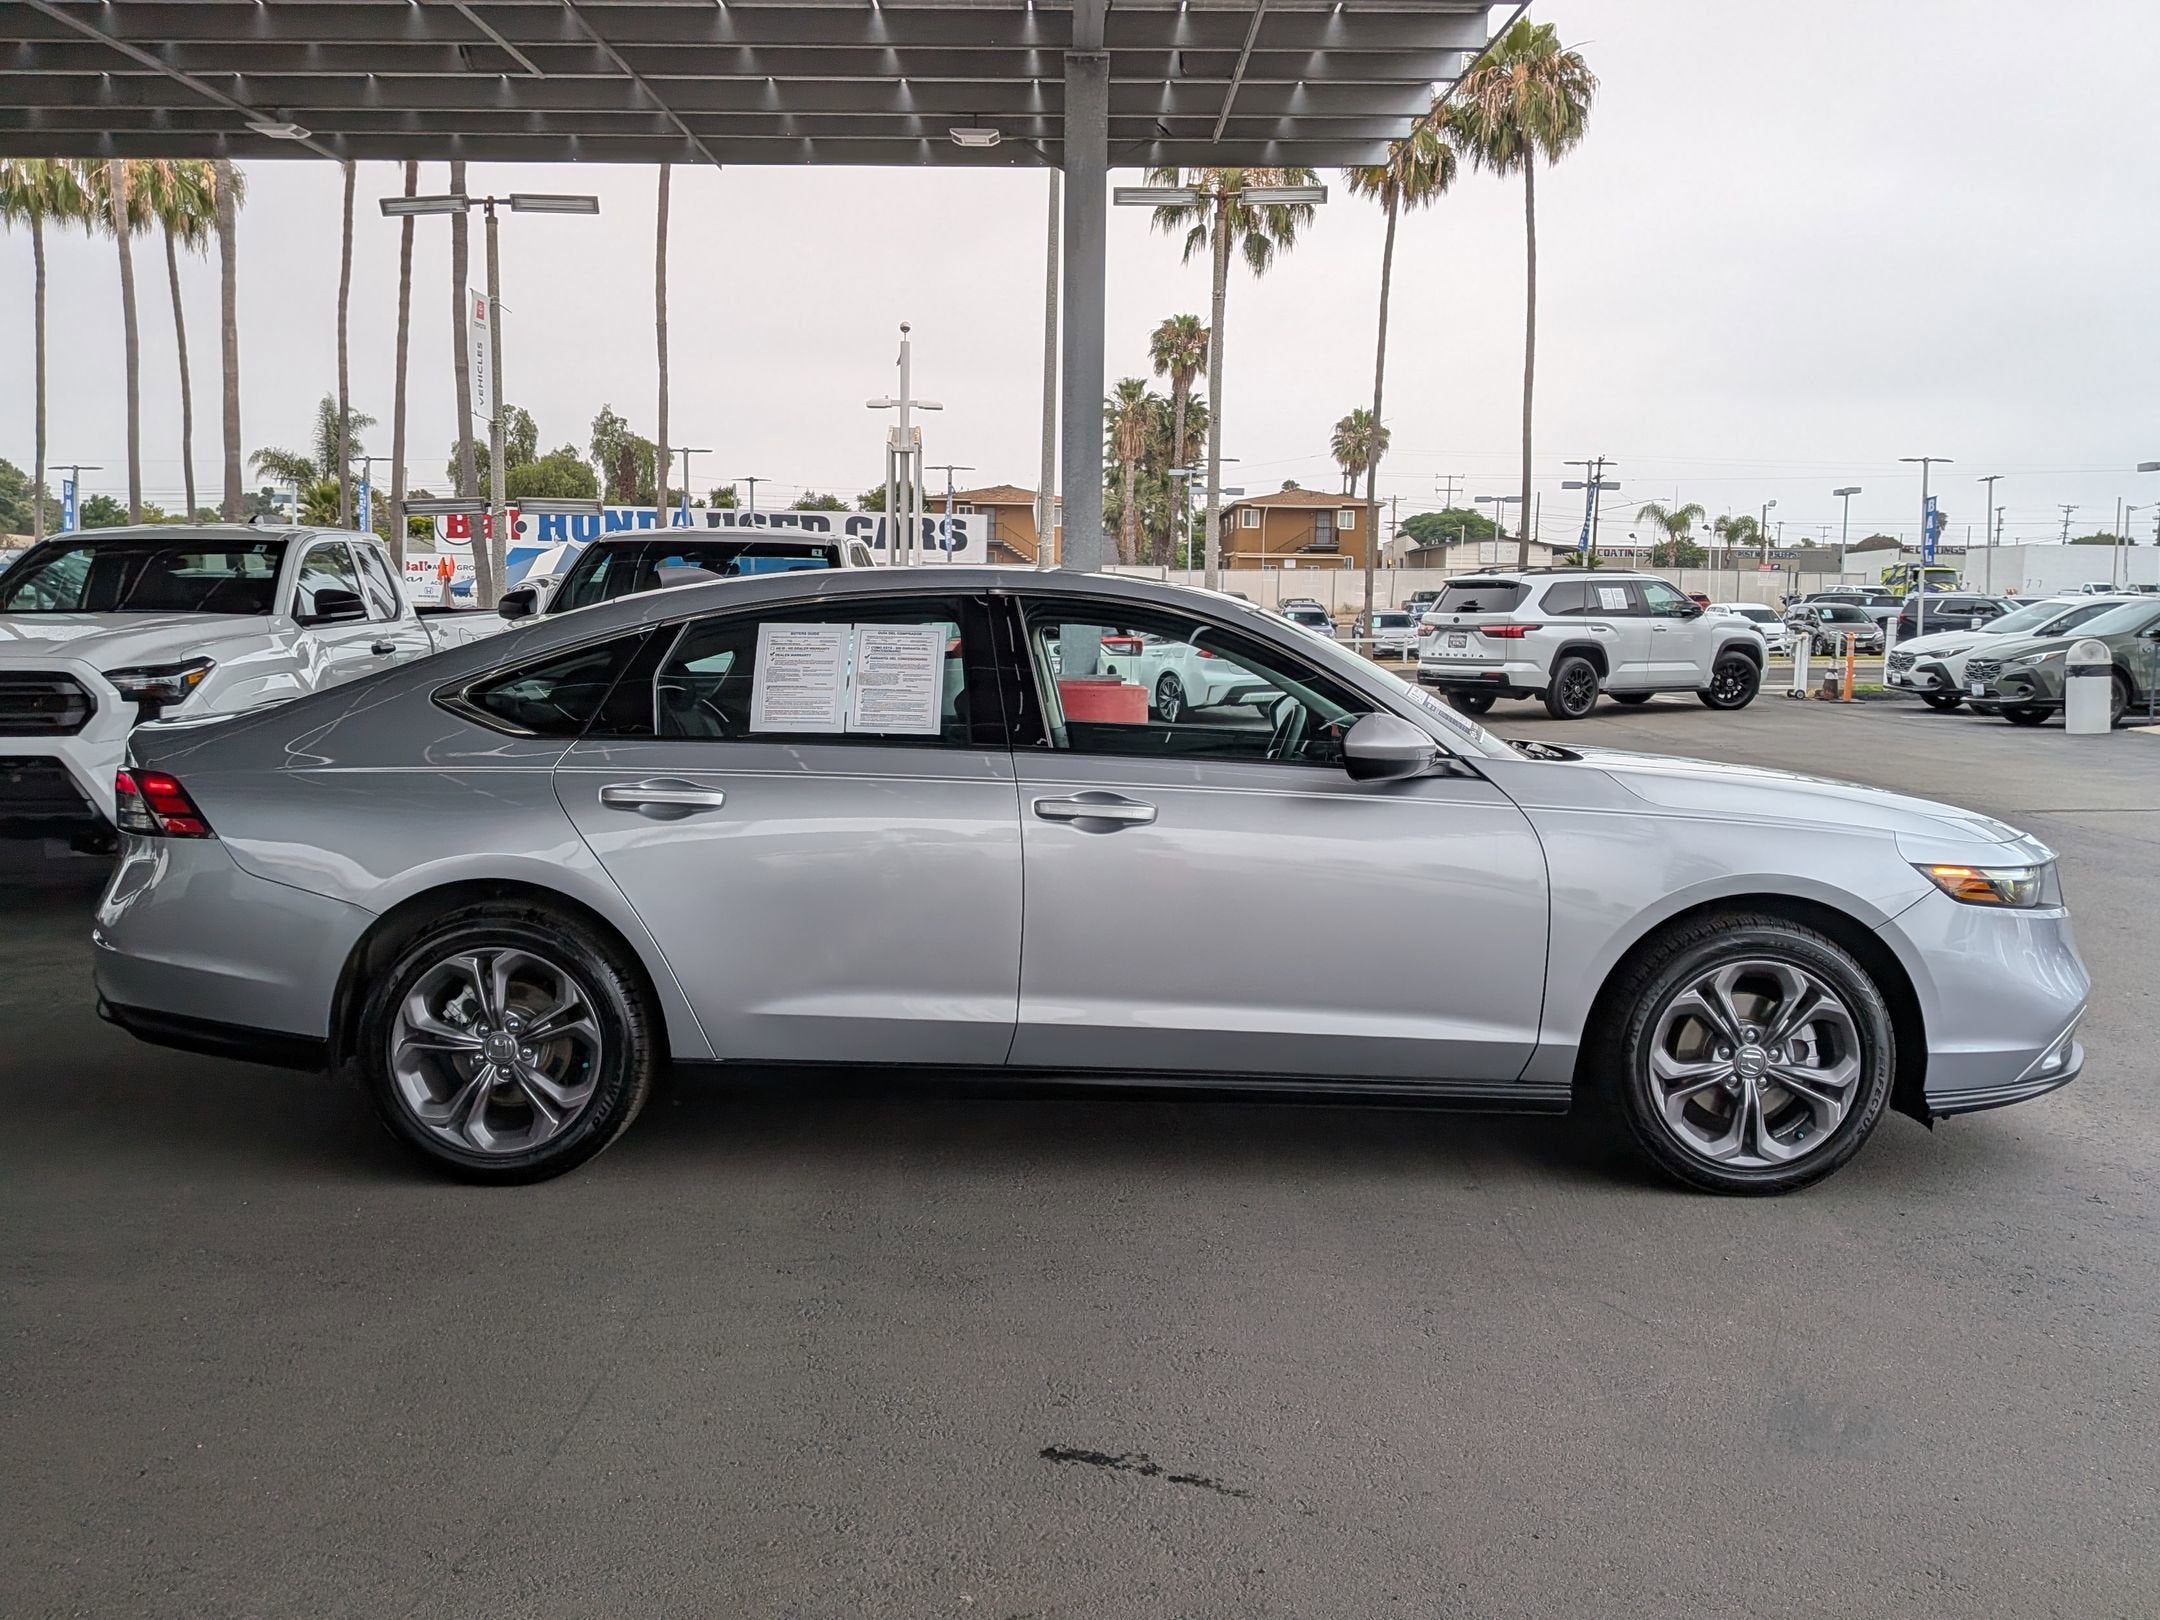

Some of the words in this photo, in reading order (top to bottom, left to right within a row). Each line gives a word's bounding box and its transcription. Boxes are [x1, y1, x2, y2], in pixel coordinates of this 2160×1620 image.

[476, 341, 484, 406] VEHICLES
[64, 482, 73, 529] BAL
[1924, 499, 1935, 562] BALL
[1597, 548, 1651, 558] COATINGS
